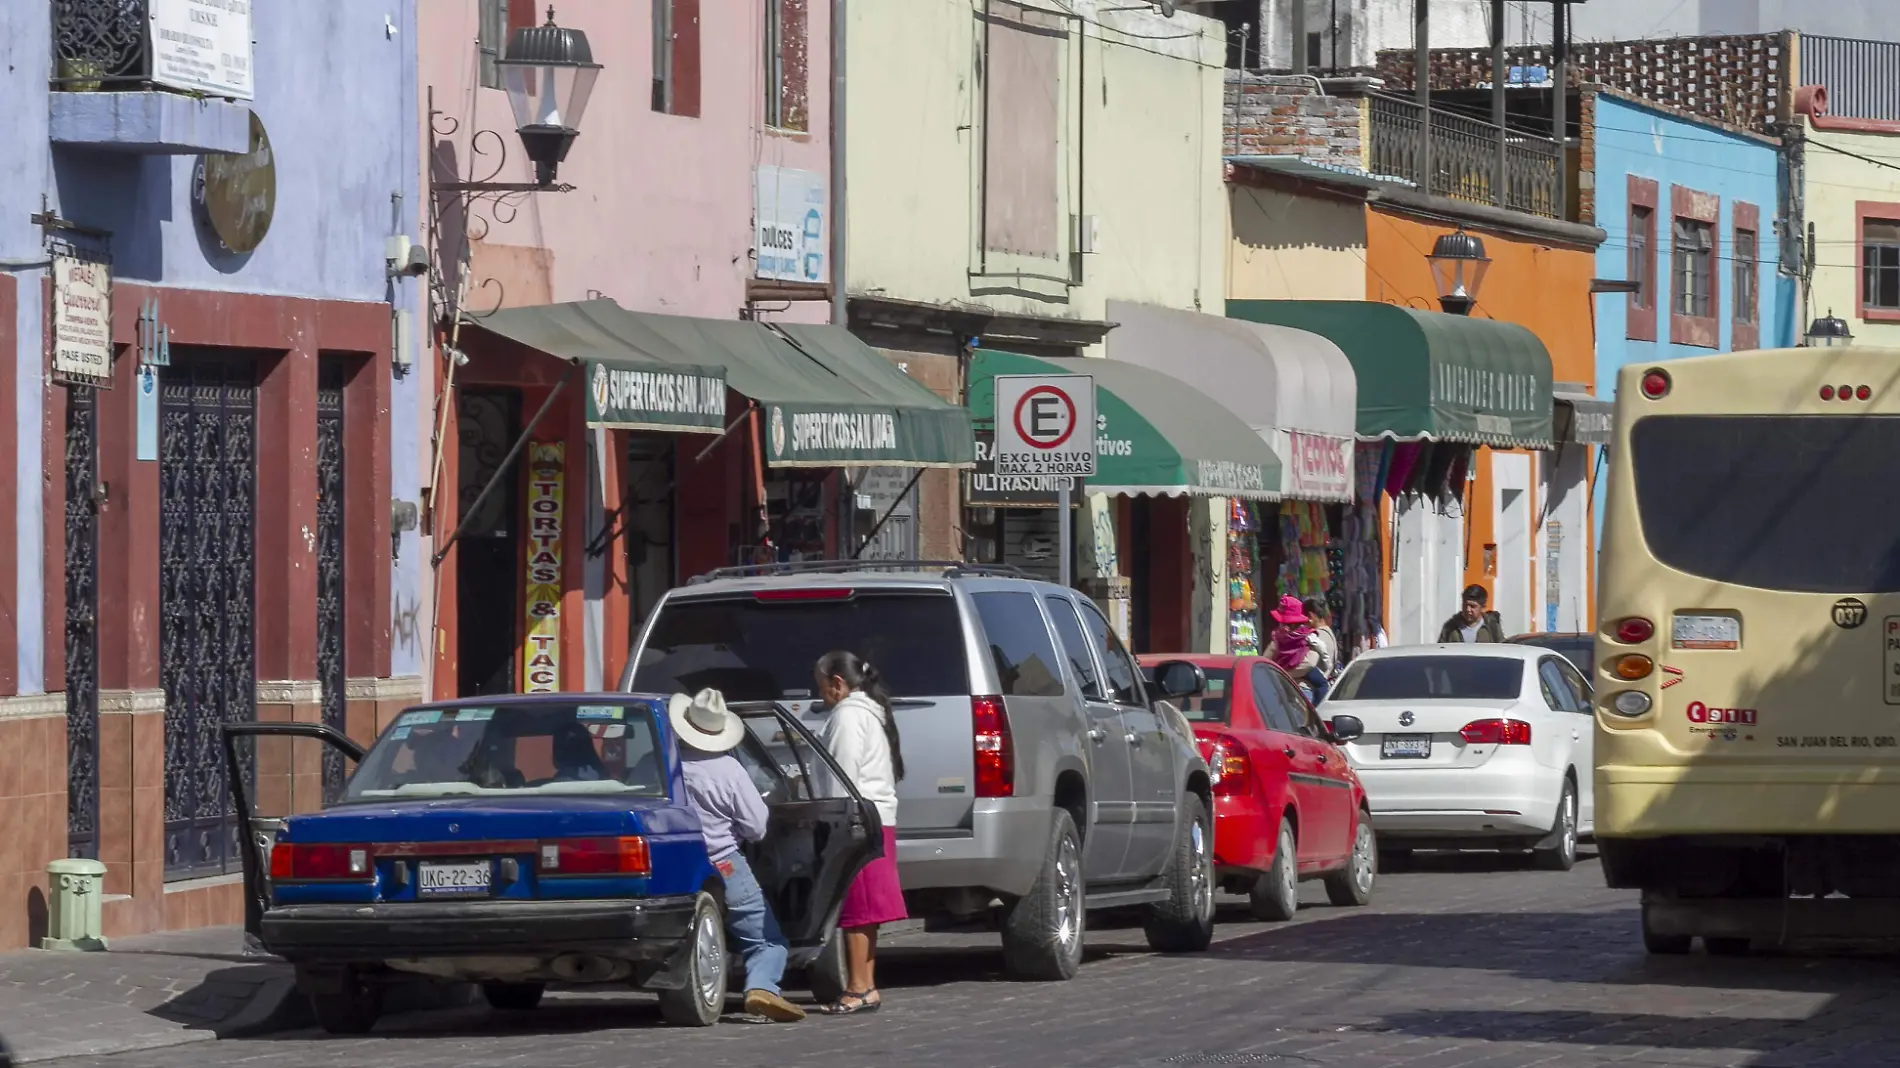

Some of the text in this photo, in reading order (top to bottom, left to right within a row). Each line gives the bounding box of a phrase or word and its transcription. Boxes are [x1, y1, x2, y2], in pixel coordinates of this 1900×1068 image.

[762, 226, 793, 249] DULCES
[61, 349, 103, 366] PASE USTED
[676, 373, 697, 414] SAN
[699, 376, 726, 416] JUAN
[1031, 397, 1060, 437] E
[850, 413, 872, 449] SAN
[1000, 452, 1092, 463] EXCLUSIVO
[1000, 462, 1092, 473] MAX. 2 HORAS
[531, 482, 560, 584] TORTAS
[531, 601, 557, 618] &
[1835, 608, 1863, 625] 037
[530, 636, 555, 692] TAC
[1709, 709, 1753, 722] 911
[1777, 736, 1797, 747] SAN
[1800, 736, 1827, 747] JUAN
[1830, 736, 1848, 747] DEL
[422, 870, 489, 886] UKG-22-36
